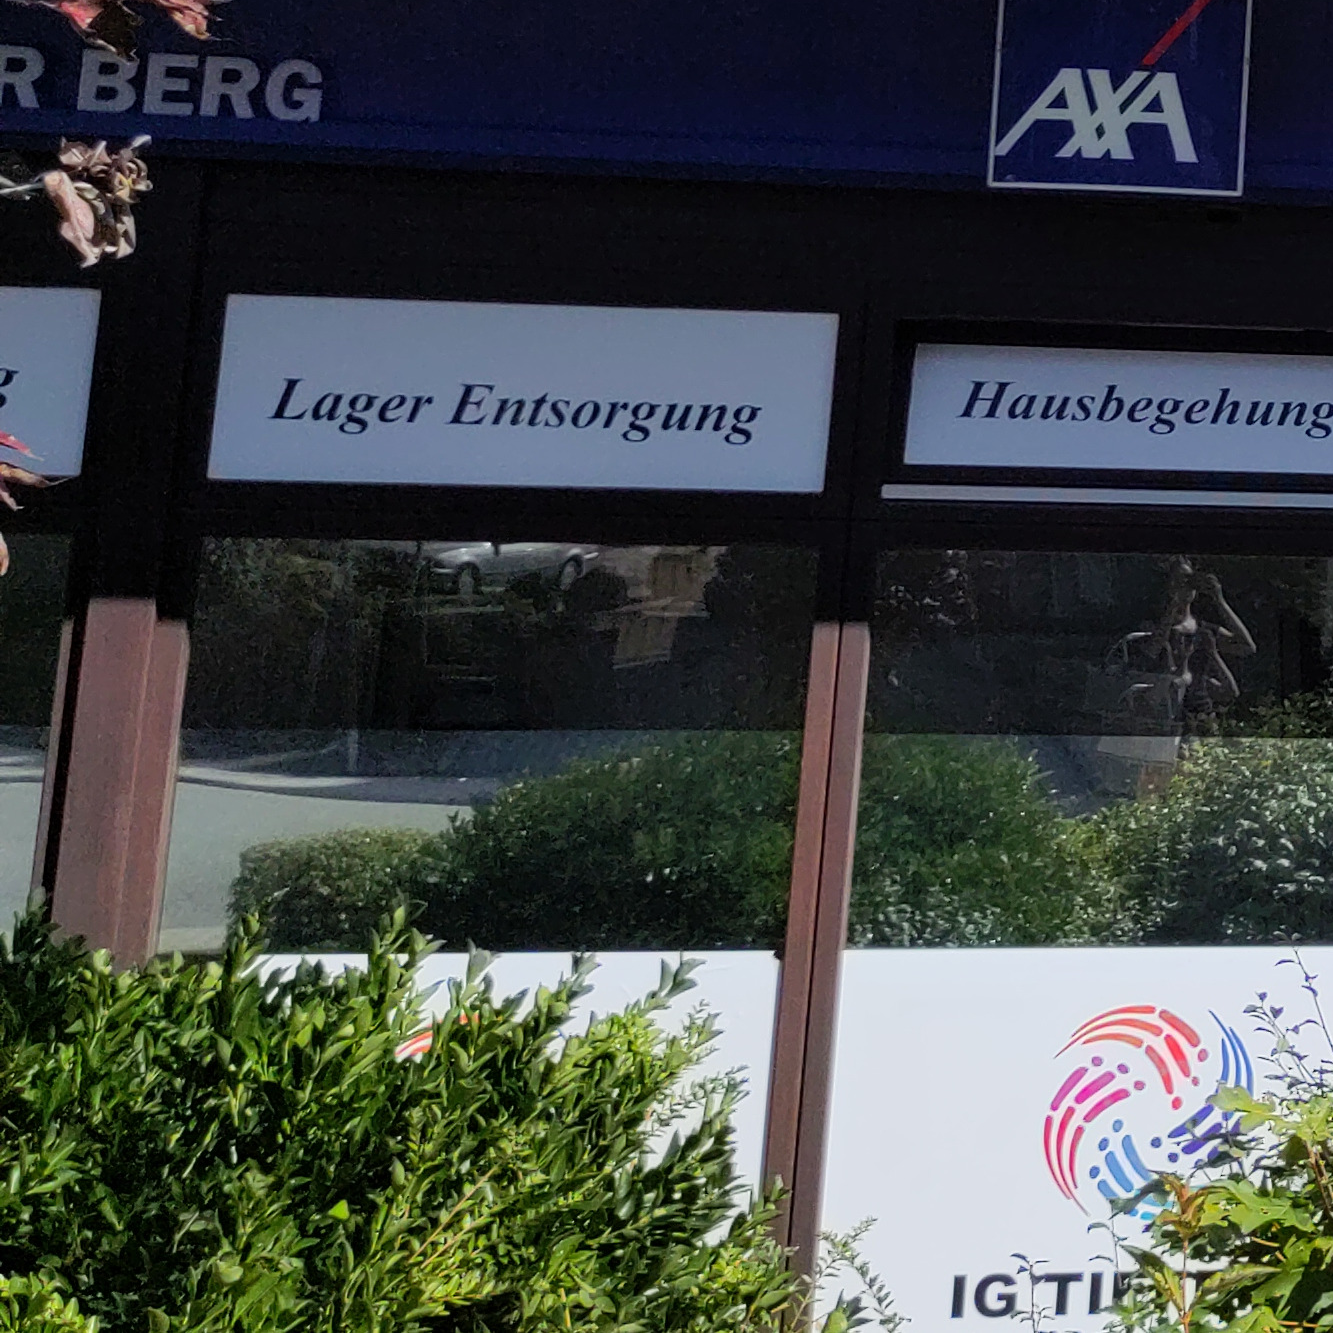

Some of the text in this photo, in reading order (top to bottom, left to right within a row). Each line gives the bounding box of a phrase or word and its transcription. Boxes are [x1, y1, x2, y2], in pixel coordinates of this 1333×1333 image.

[76, 48, 323, 123] BERG
[994, 67, 1199, 164] AXA
[269, 377, 763, 446] Lager Entsorgung
[950, 1273, 1018, 1319] IG
